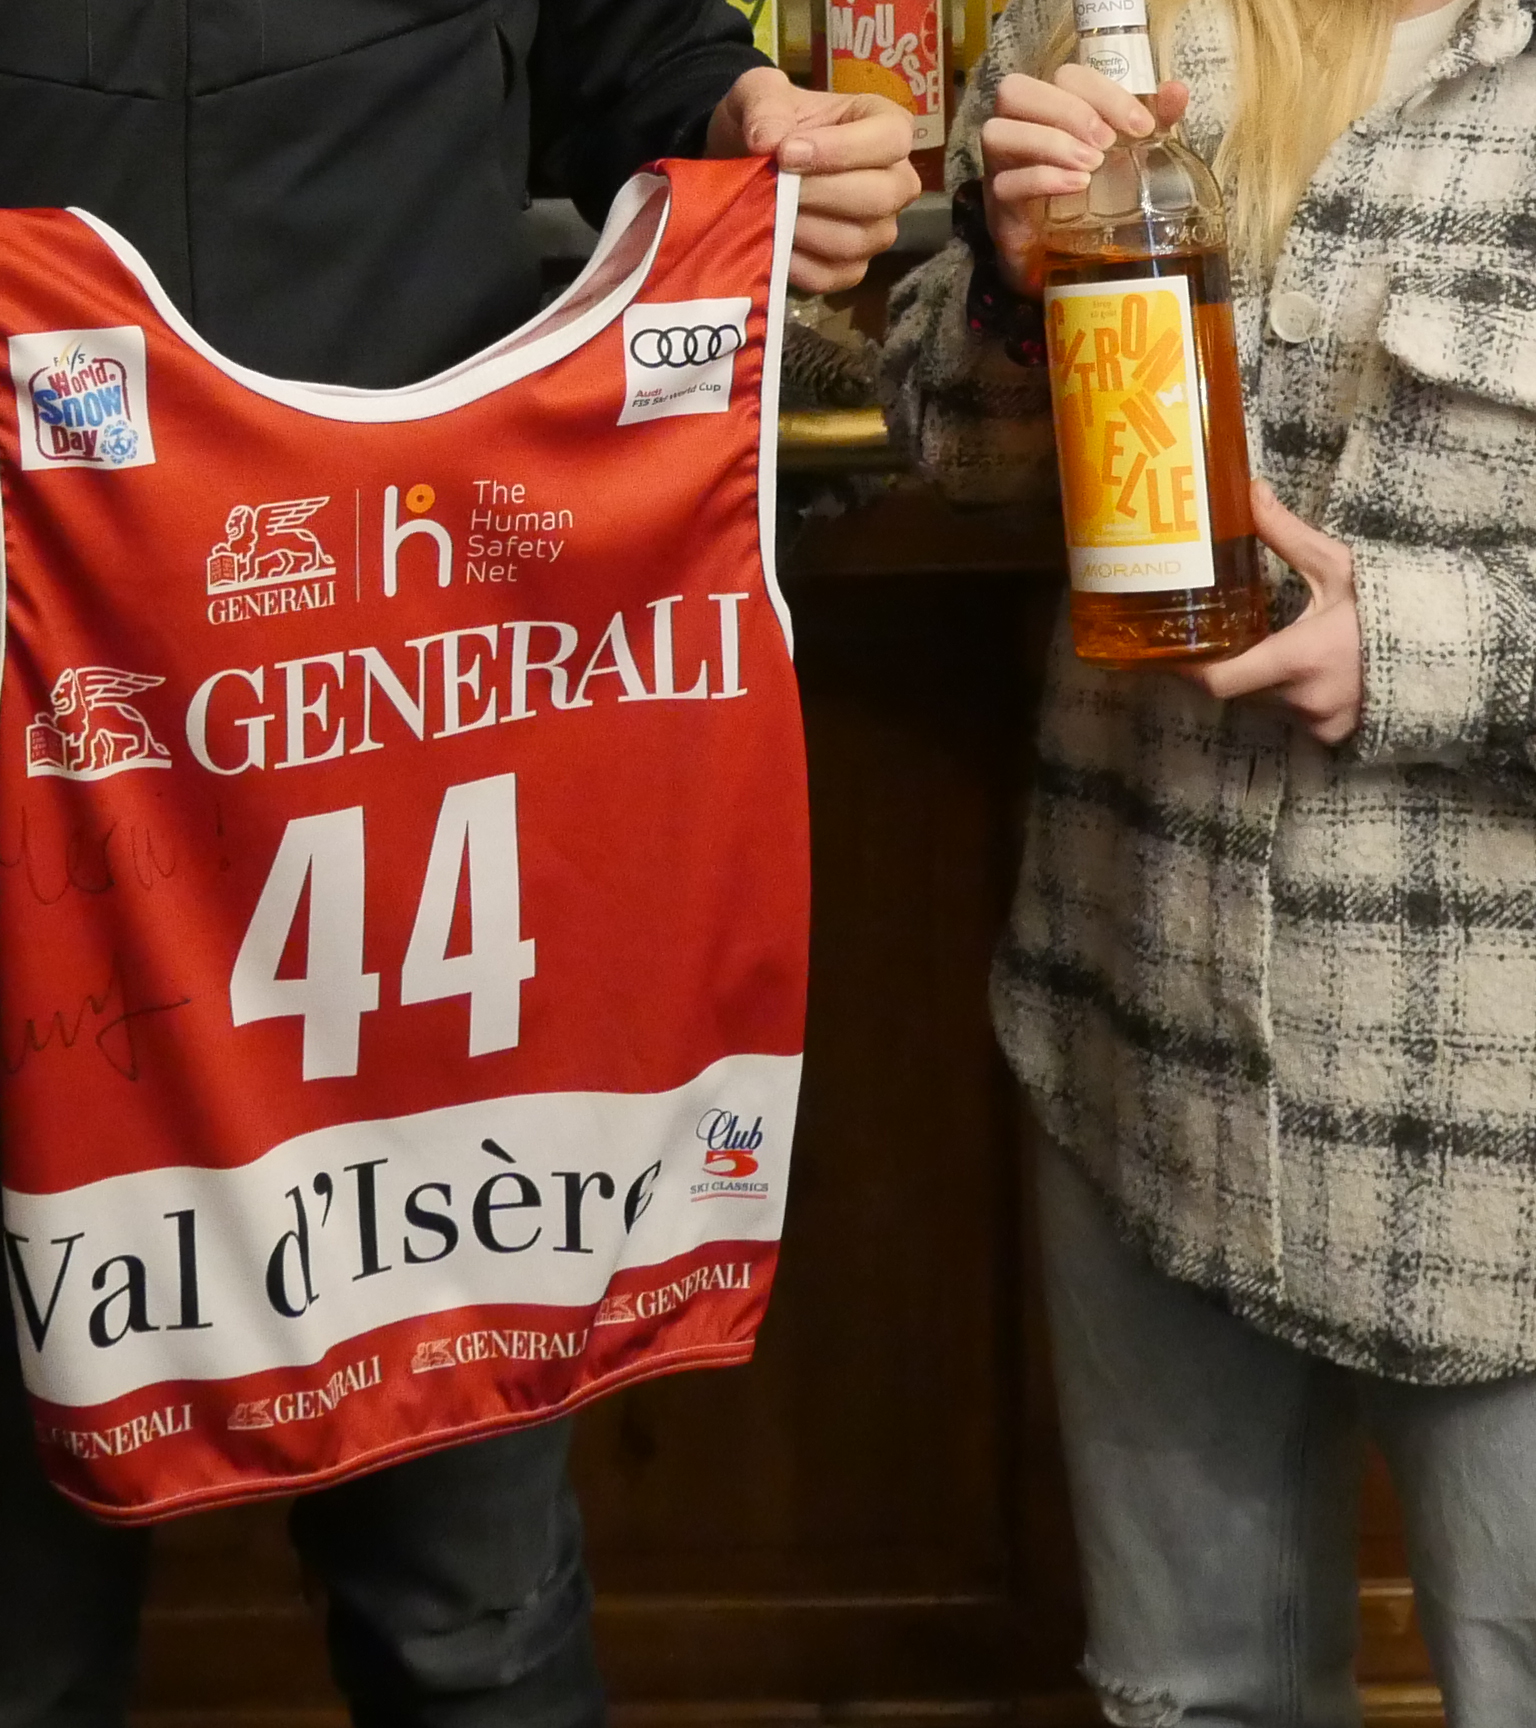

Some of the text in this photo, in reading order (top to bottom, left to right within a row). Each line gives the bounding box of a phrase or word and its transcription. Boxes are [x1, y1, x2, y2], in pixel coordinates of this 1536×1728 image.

[1076, 0, 1135, 16] ORAND
[631, 398, 650, 408] FIS
[698, 382, 721, 393] Cup
[635, 387, 663, 398] Audi
[50, 425, 98, 457] Day
[472, 479, 526, 505] The
[470, 508, 574, 533] Human
[467, 535, 565, 563] Safety
[466, 561, 518, 585] Net
[1083, 560, 1182, 578] MORAND
[207, 581, 336, 625] GENERALI
[185, 592, 750, 776] GENERALI
[229, 772, 536, 1082] 44
[696, 1108, 763, 1151] Club
[702, 1149, 759, 1179] 5
[690, 1180, 769, 1195] SKI CLASSICS
[4, 1208, 214, 1354] Val
[636, 1261, 752, 1319] GENERALI
[455, 1327, 590, 1364] GENERALI
[274, 1354, 382, 1424] GENRALI
